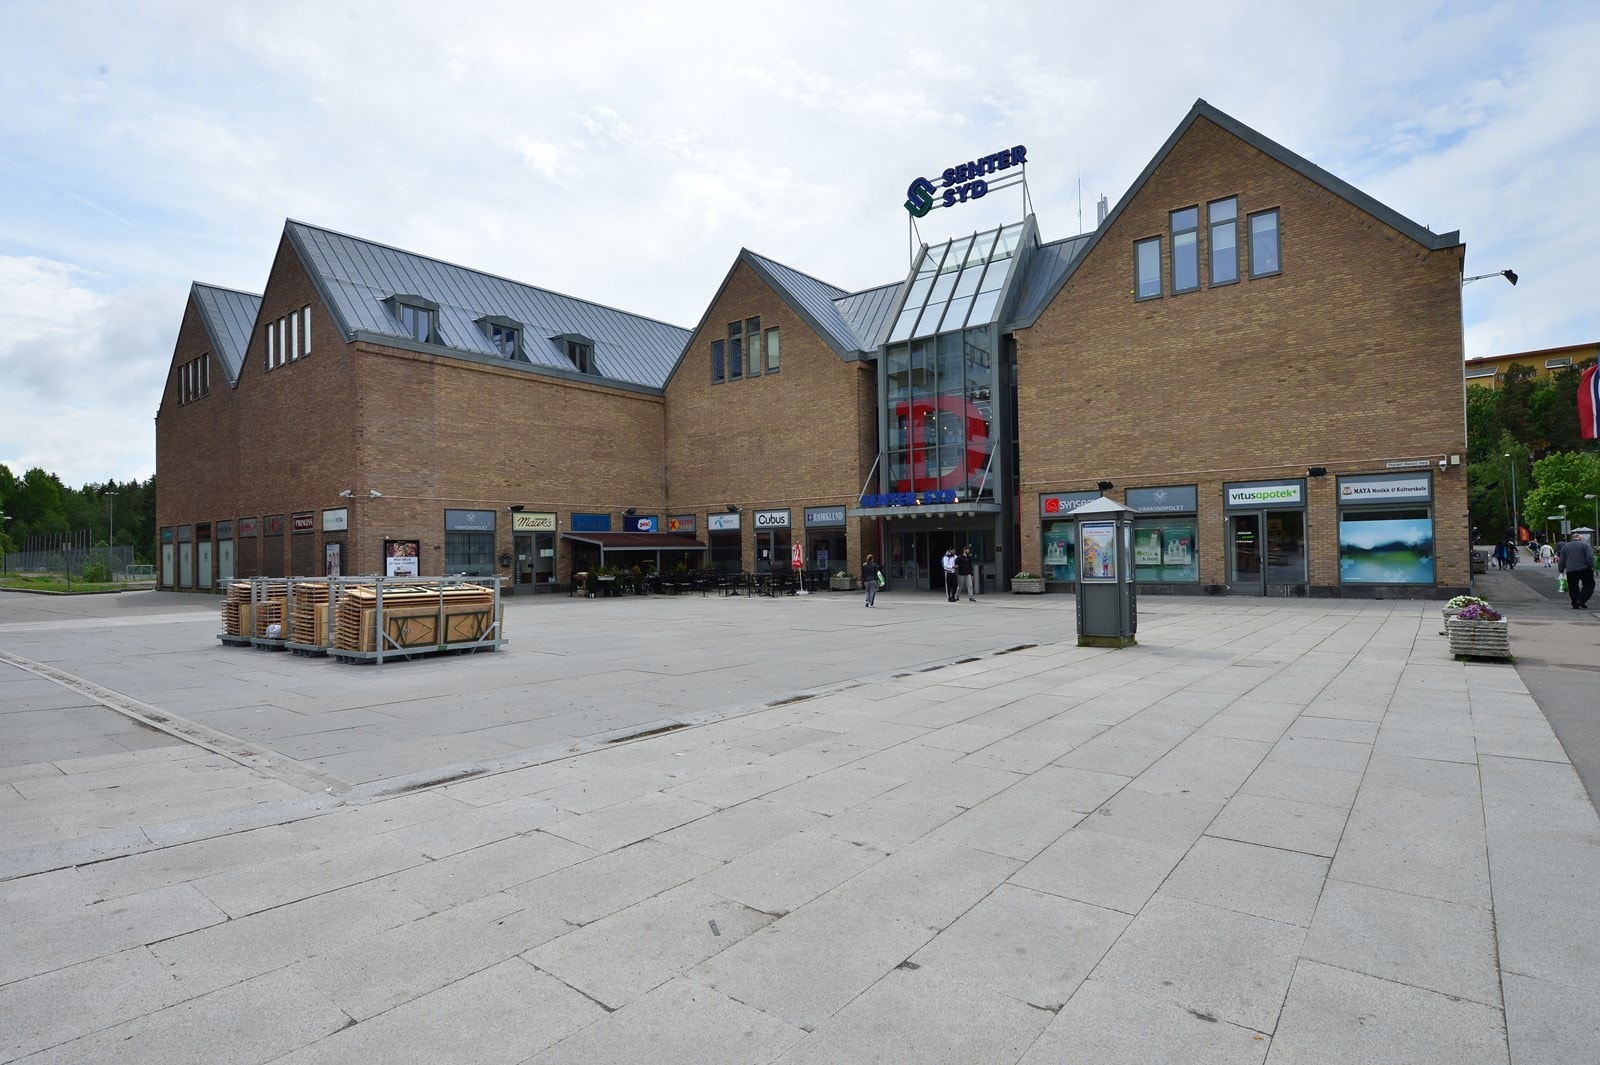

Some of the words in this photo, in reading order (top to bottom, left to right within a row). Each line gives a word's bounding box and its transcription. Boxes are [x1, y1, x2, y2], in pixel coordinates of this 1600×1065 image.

[941, 144, 1028, 188] SENTER
[942, 179, 988, 208] SYD
[860, 492, 916, 508] SENTER
[923, 489, 957, 504] SYD
[1137, 504, 1184, 512] VINMONOPOLET
[295, 518, 313, 527] PRINCESS
[758, 514, 786, 525] Cubus
